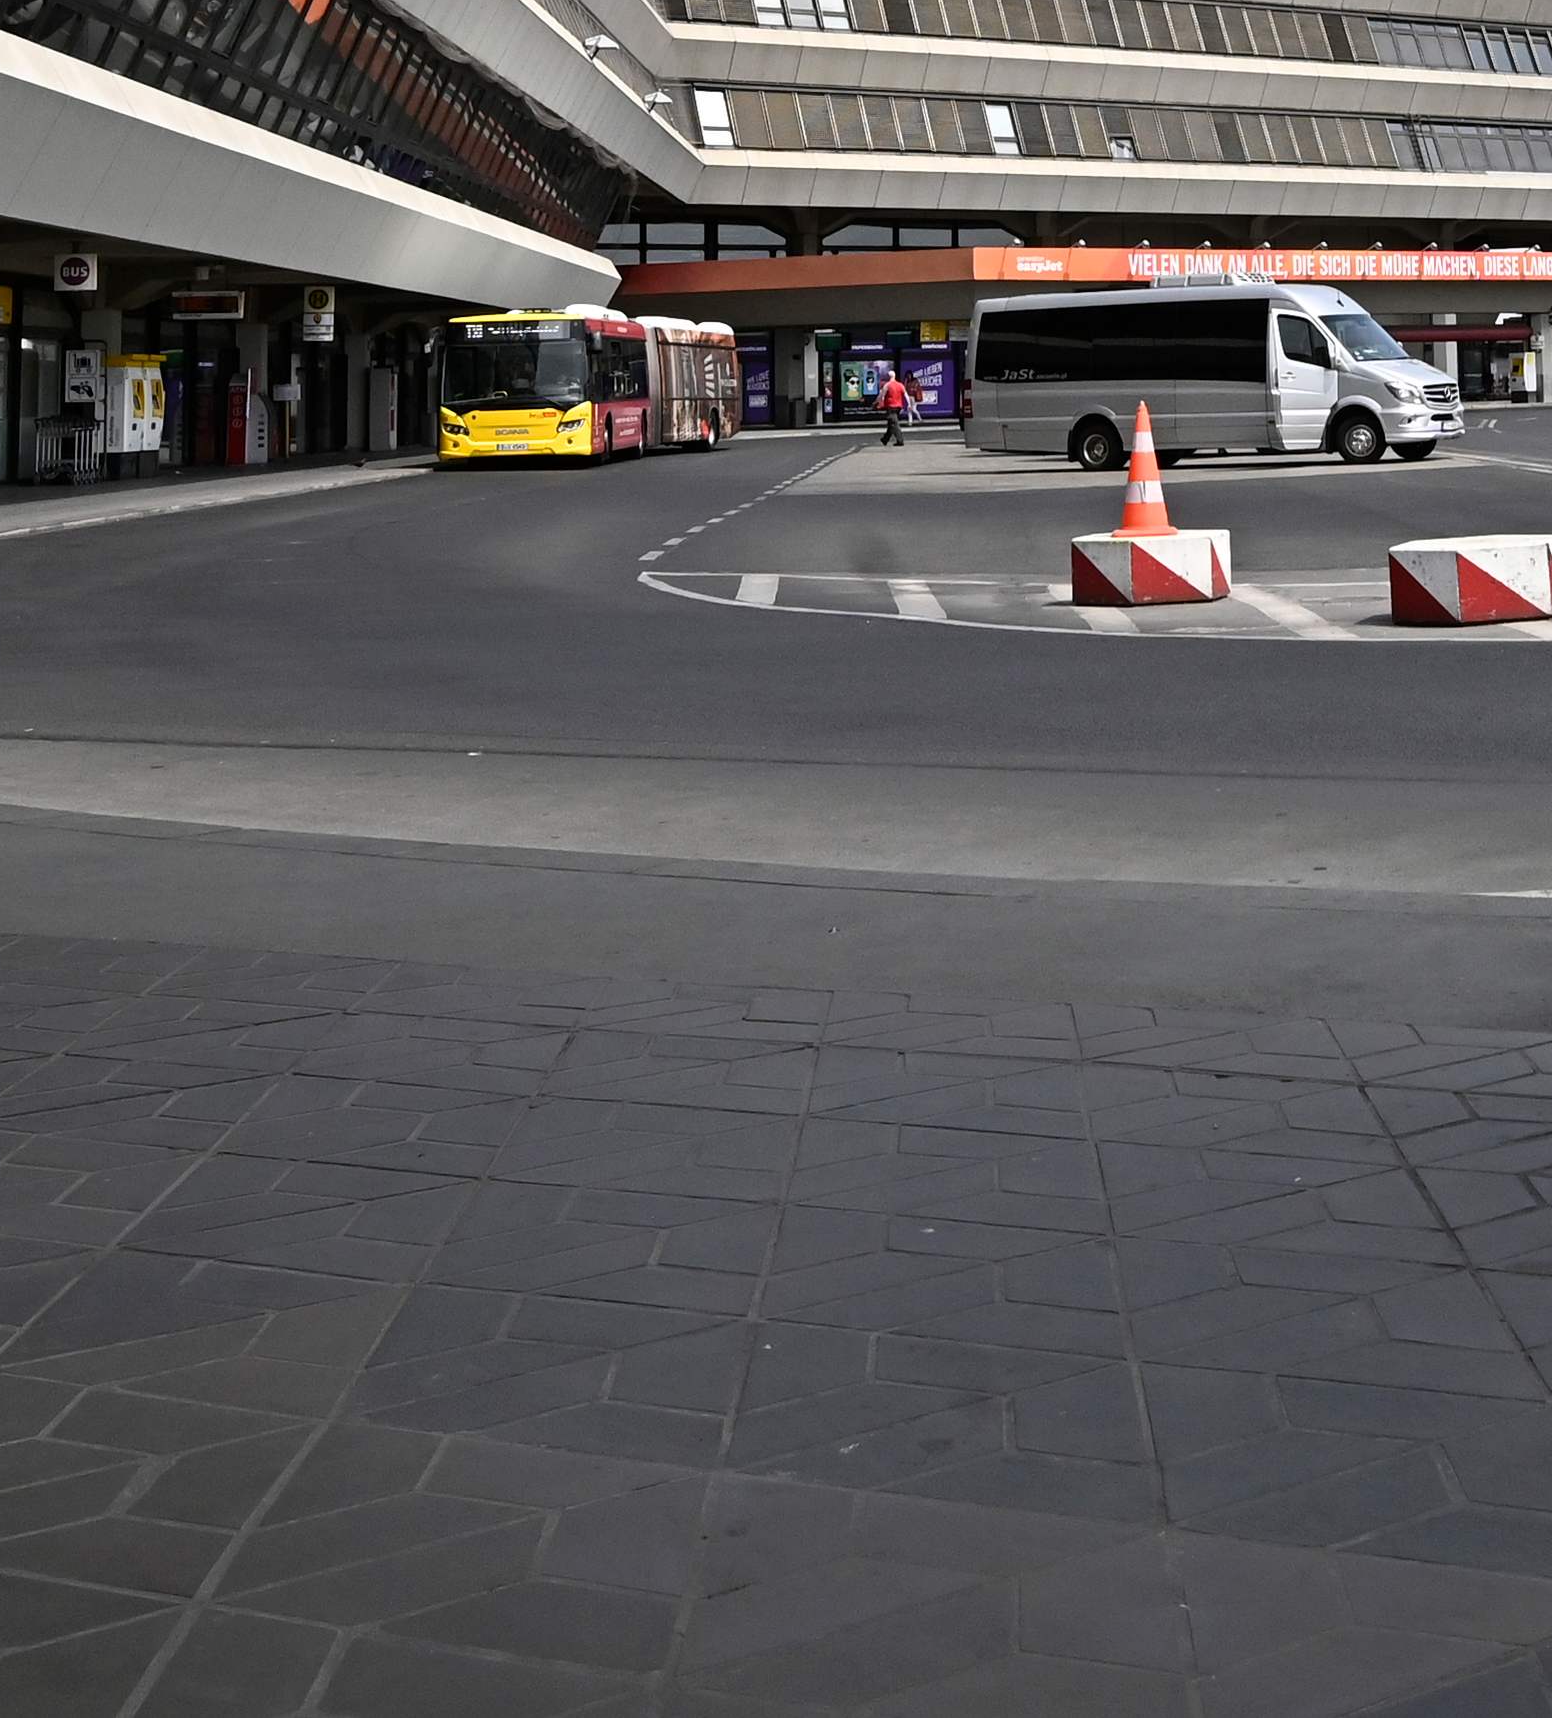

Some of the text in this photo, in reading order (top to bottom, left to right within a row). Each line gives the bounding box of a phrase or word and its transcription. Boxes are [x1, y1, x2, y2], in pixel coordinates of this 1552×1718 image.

[62, 266, 89, 278] BUS
[1128, 253, 1180, 276] VIELEN
[1184, 254, 1223, 275] DANK
[1229, 254, 1247, 275] AN
[1251, 254, 1289, 279] ALLE,
[1292, 255, 1316, 276] DIE
[1319, 255, 1351, 276] SICH
[1355, 255, 1378, 276] DIE
[1381, 253, 1420, 276] MÜHE
[1424, 255, 1481, 280] MACHEN,
[1484, 256, 1520, 276] DIESE
